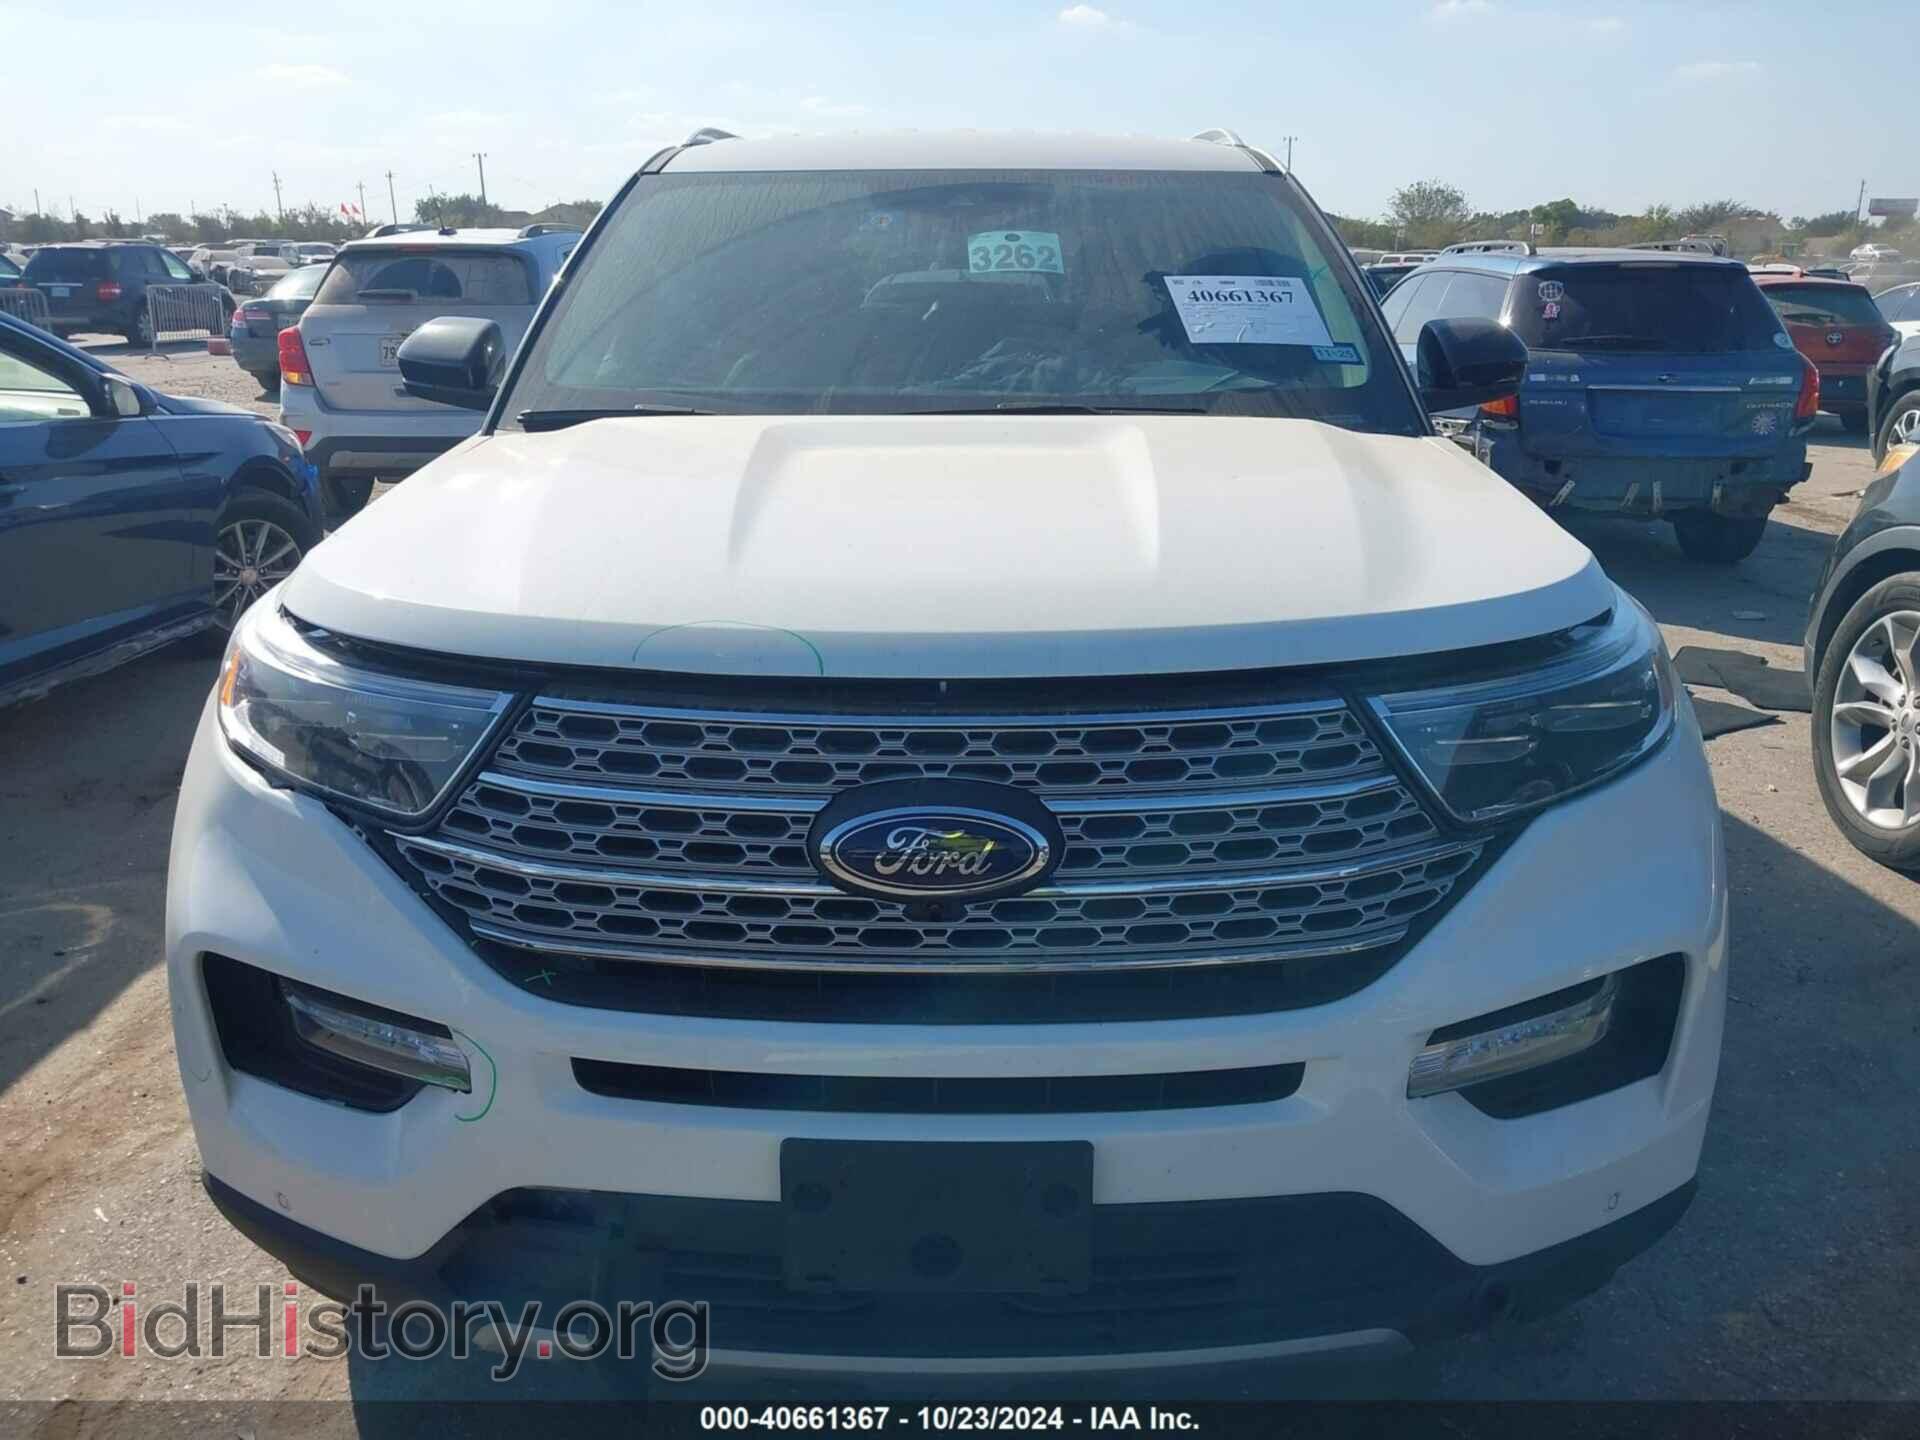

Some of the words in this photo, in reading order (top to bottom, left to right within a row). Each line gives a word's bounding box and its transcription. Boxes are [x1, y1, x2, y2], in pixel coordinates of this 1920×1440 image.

[972, 244, 1058, 271] 3262
[1187, 289, 1294, 304] 40661367
[873, 826, 996, 876] Ford
